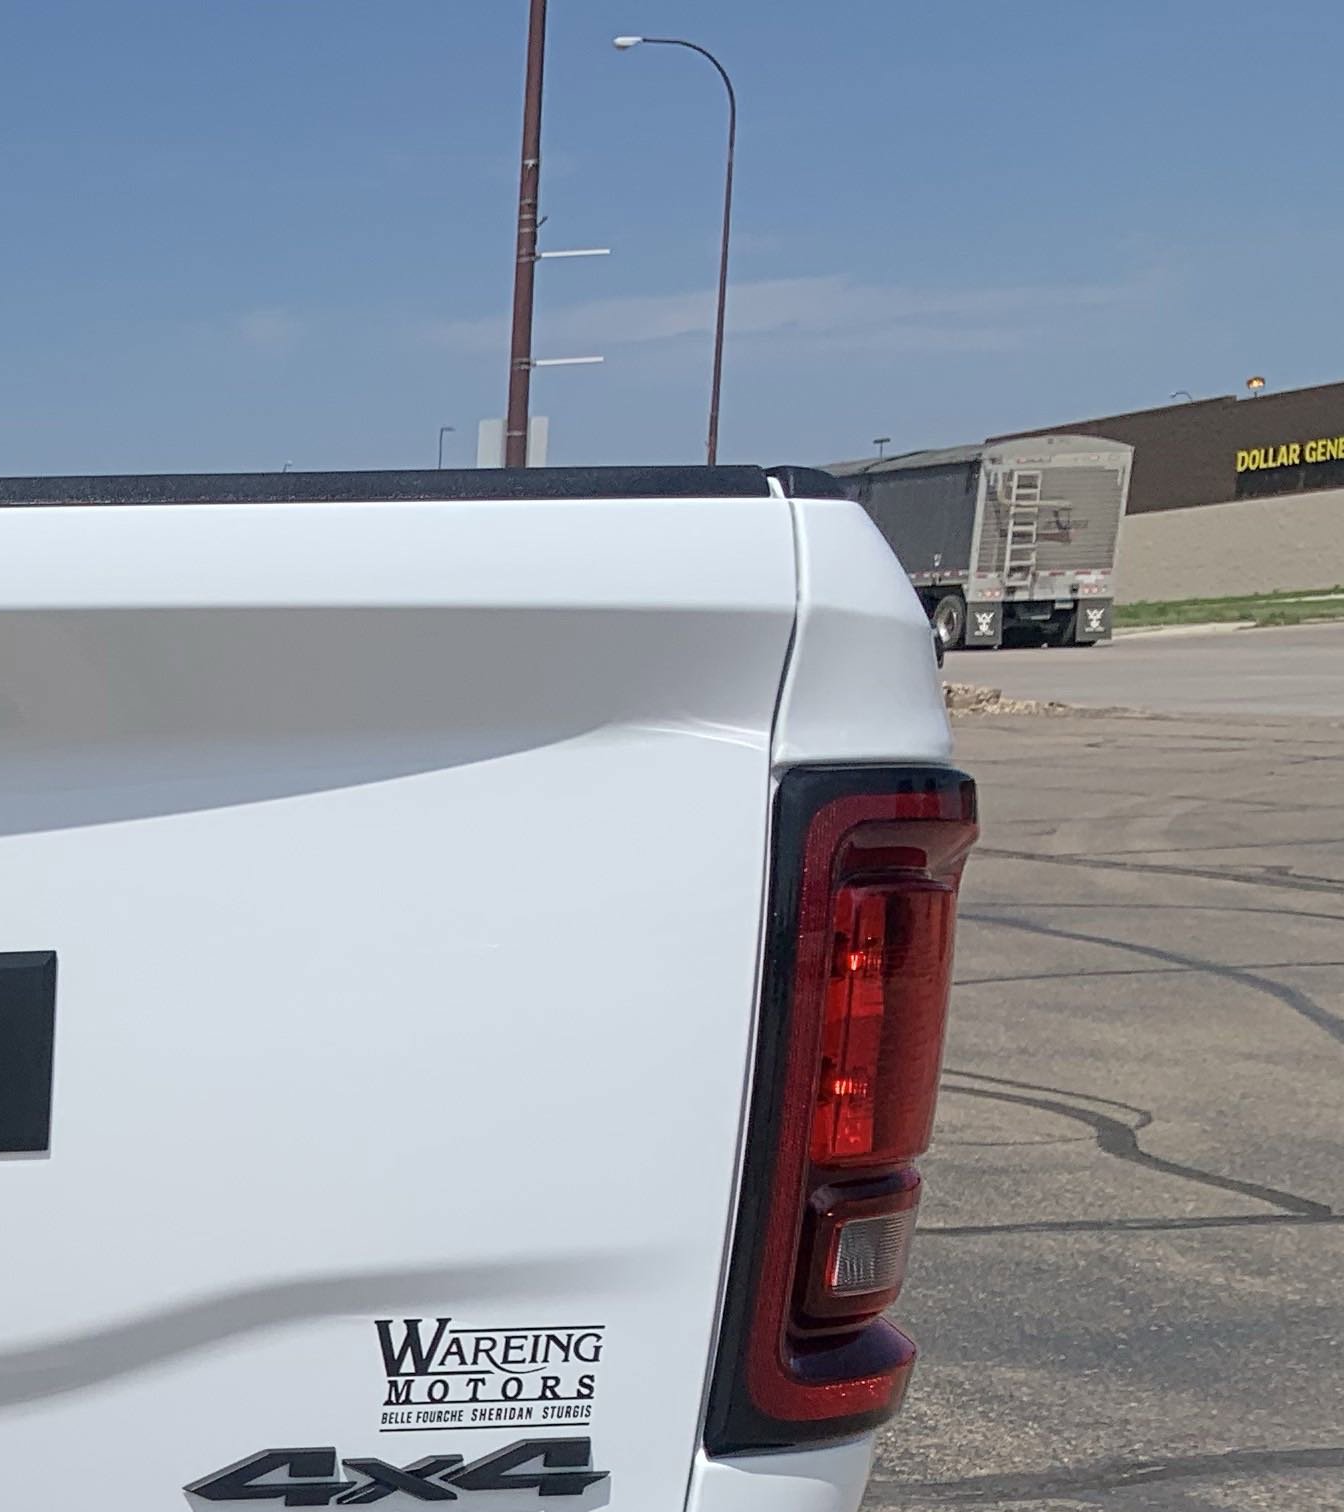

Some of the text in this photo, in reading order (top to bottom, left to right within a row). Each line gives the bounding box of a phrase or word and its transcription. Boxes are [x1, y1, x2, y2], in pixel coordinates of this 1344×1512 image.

[1236, 443, 1300, 472] DOLLAR
[374, 1317, 603, 1376] WAREING
[383, 1375, 595, 1405] MOTORS
[381, 1404, 592, 1425] BELLE FOURCHE SHERIDAN STURGIS
[182, 1437, 611, 1507] 4x4
